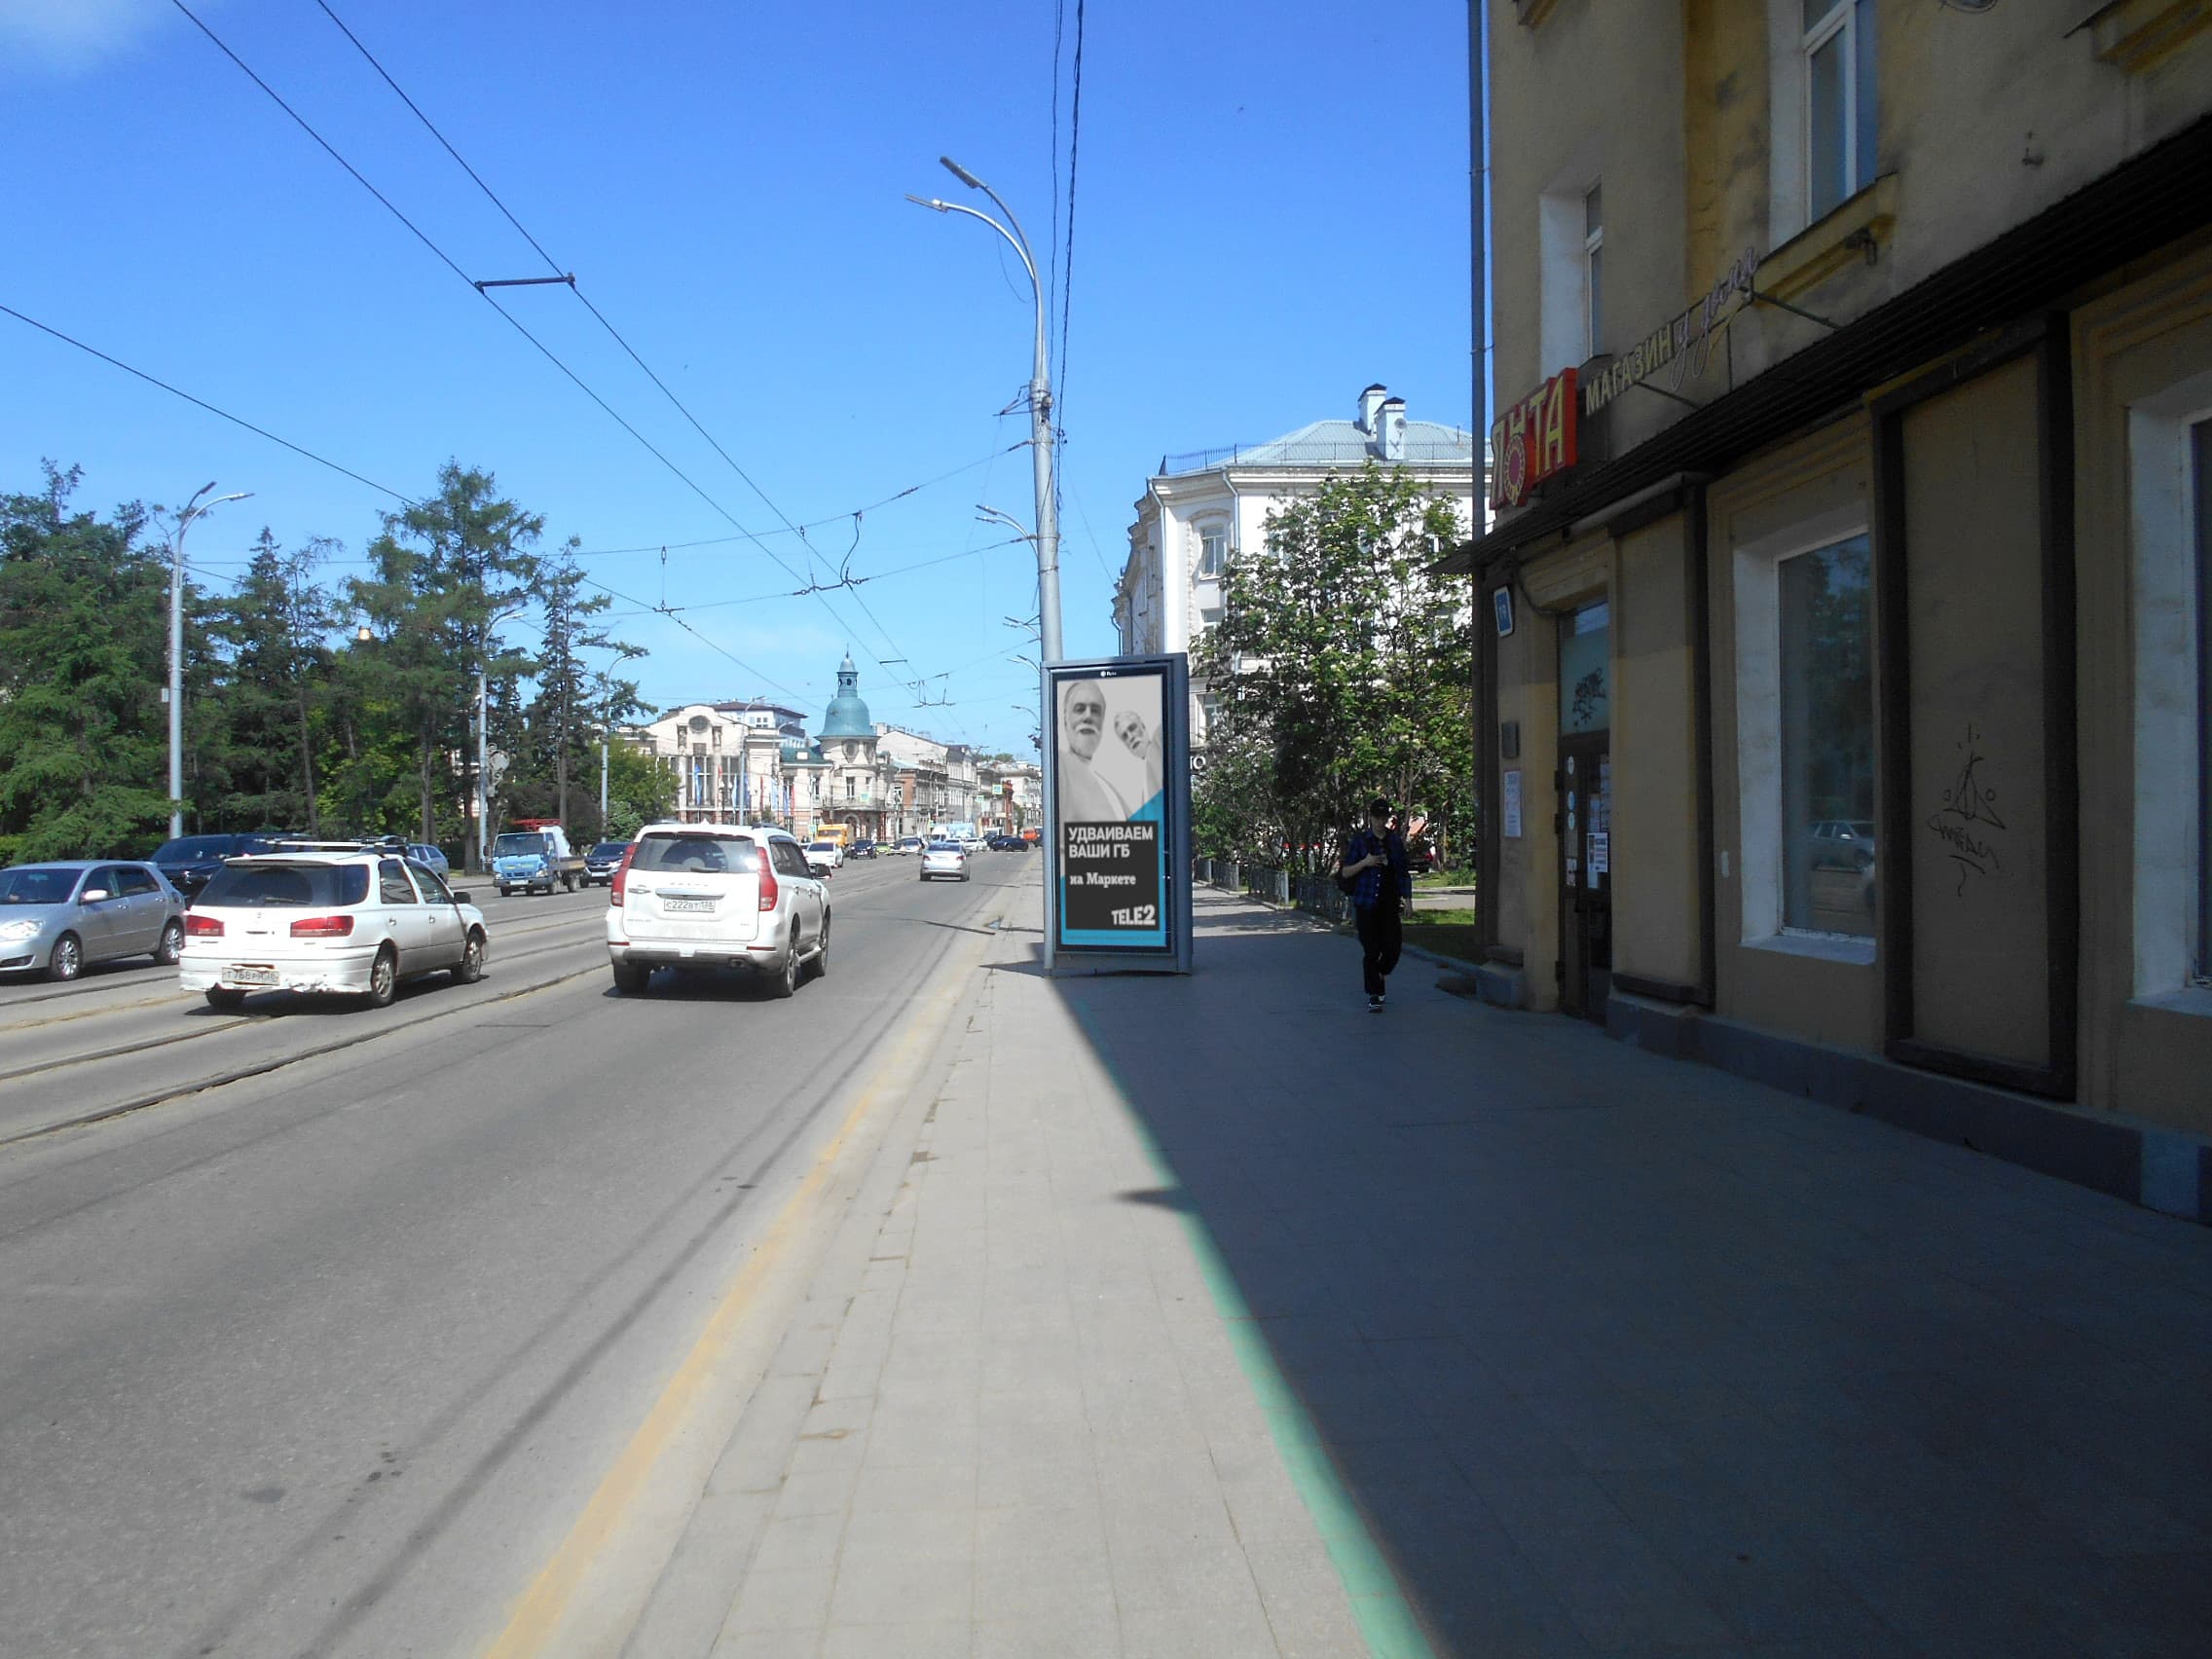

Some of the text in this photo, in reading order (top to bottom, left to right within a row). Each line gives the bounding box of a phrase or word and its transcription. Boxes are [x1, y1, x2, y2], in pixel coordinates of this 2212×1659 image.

[1586, 322, 1674, 416] МАГАЗИН
[1068, 826, 1154, 844] УДВАИВАЕМ
[1068, 844, 1130, 858] ВАШИ ГБ
[1070, 872, 1136, 888] на Маркете
[1111, 904, 1156, 926] TELE2
